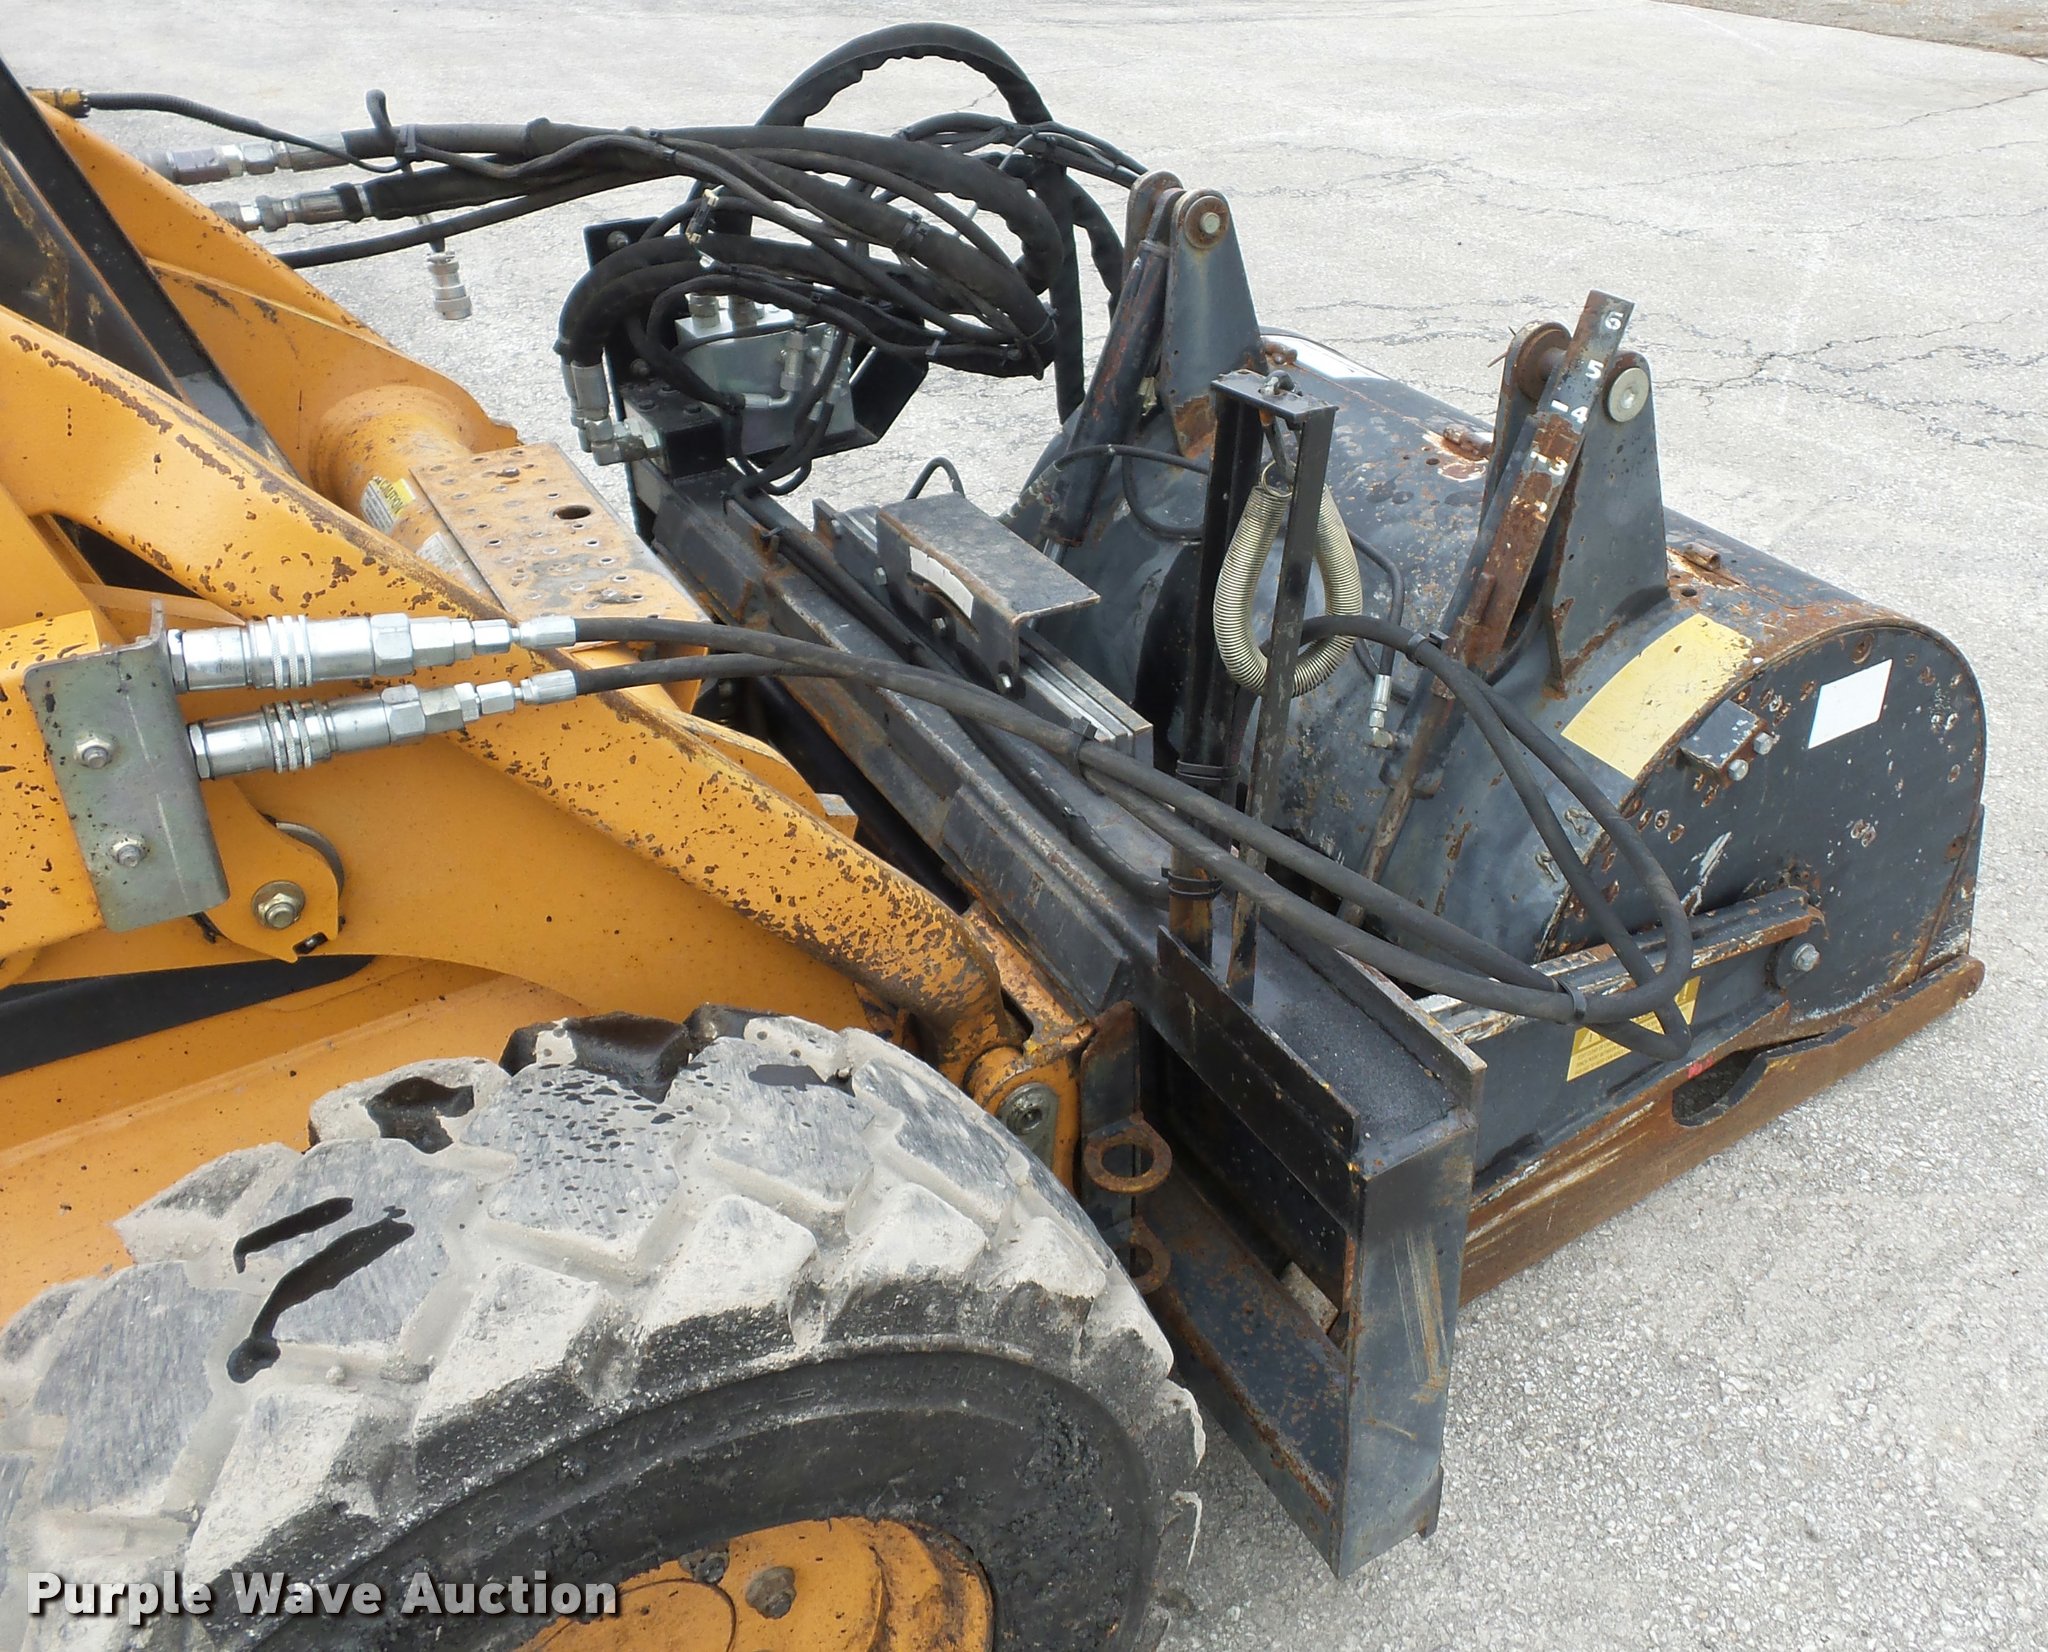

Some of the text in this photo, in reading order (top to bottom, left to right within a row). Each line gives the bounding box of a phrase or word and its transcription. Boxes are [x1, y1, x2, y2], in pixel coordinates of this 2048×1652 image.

[1605, 312, 1624, 331] 6
[1585, 360, 1604, 379] 5
[1571, 406, 1588, 424] 4
[1549, 457, 1568, 476] 3
[379, 480, 403, 514] CAUTION
